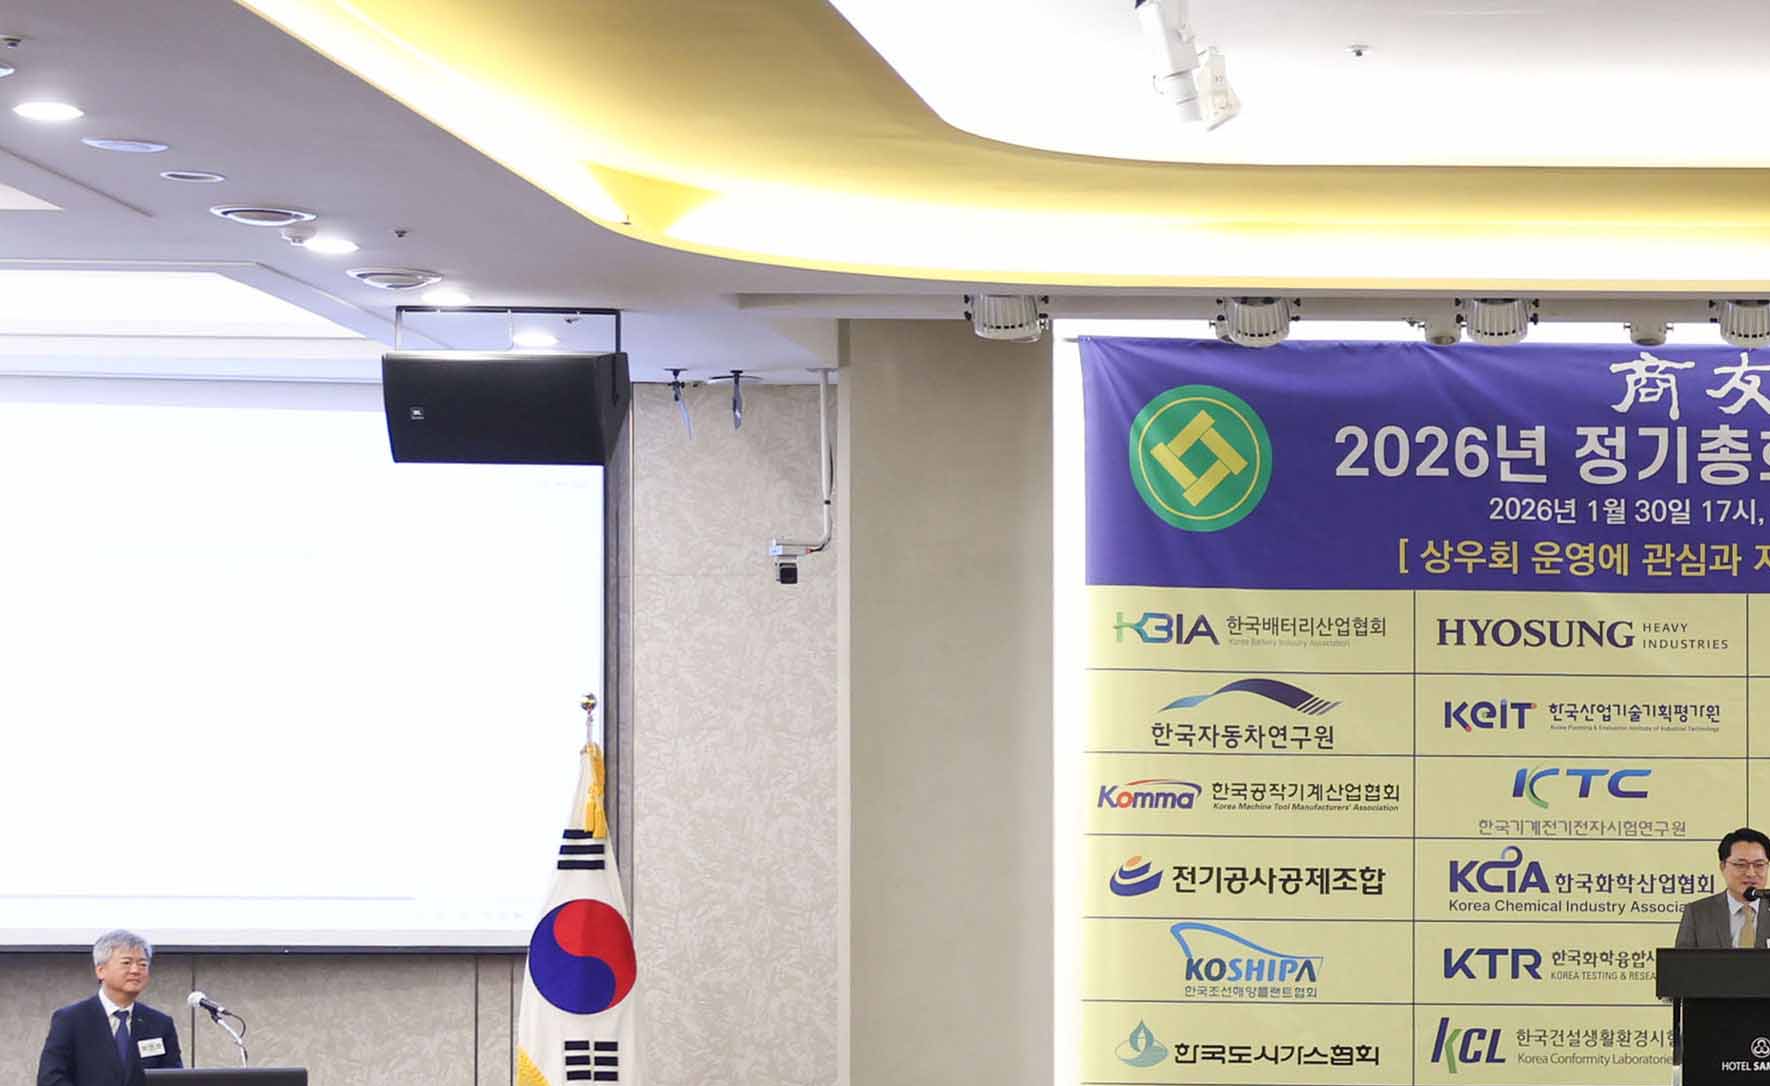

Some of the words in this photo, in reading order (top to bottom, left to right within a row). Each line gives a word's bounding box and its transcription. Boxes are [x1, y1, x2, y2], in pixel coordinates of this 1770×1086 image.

[1333, 425, 1548, 485] 2026년
[1488, 497, 1577, 526] 2026년
[1587, 497, 1627, 526] 1월
[1633, 497, 1692, 526] 30일
[1701, 497, 1765, 527] 17시,
[1420, 539, 1520, 576] 상우회
[1531, 539, 1630, 577] 운영에
[1641, 540, 1742, 578] 관심과
[1113, 612, 1220, 645] KBIA
[1226, 615, 1387, 637] 한국배터리산업협회
[1436, 618, 1635, 648] HYOSUNG
[1643, 623, 1688, 633] HEAVY
[1643, 639, 1729, 649] INDUSTRIES
[1549, 703, 1721, 723] 한국산업기술기획평가원
[1151, 722, 1335, 750] 한국자동차연구원
[1097, 784, 1196, 809] Komma
[1212, 782, 1400, 802] 한국공작기계산업협회
[1513, 767, 1652, 808] KTC
[1274, 803, 1290, 811] Tool
[1353, 803, 1399, 811] Association
[1478, 819, 1687, 837] 한국기계전기전자시험연구원
[1172, 866, 1386, 895] 전기공사공제조합
[1555, 873, 1715, 895] 한국화학산업협회
[1449, 899, 1490, 912] Korea
[1495, 899, 1562, 912] Chemical
[1566, 899, 1625, 915] Industry
[1631, 900, 1685, 913] Associa
[1185, 958, 1317, 983] KOSHIPA
[1443, 948, 1543, 979] KTR
[1551, 971, 1580, 980] KOREA
[1582, 971, 1617, 980] TESTING
[1629, 970, 1656, 980] RESEA
[1184, 985, 1317, 998] 한국조선해양플랜트협회
[1174, 1043, 1380, 1066] 한국도시가스협회
[1518, 1053, 1548, 1064] Korea
[1551, 1053, 1611, 1066] Conformity
[1613, 1053, 1673, 1065] Laboratorie
[1721, 1061, 1751, 1071] HOTEL
